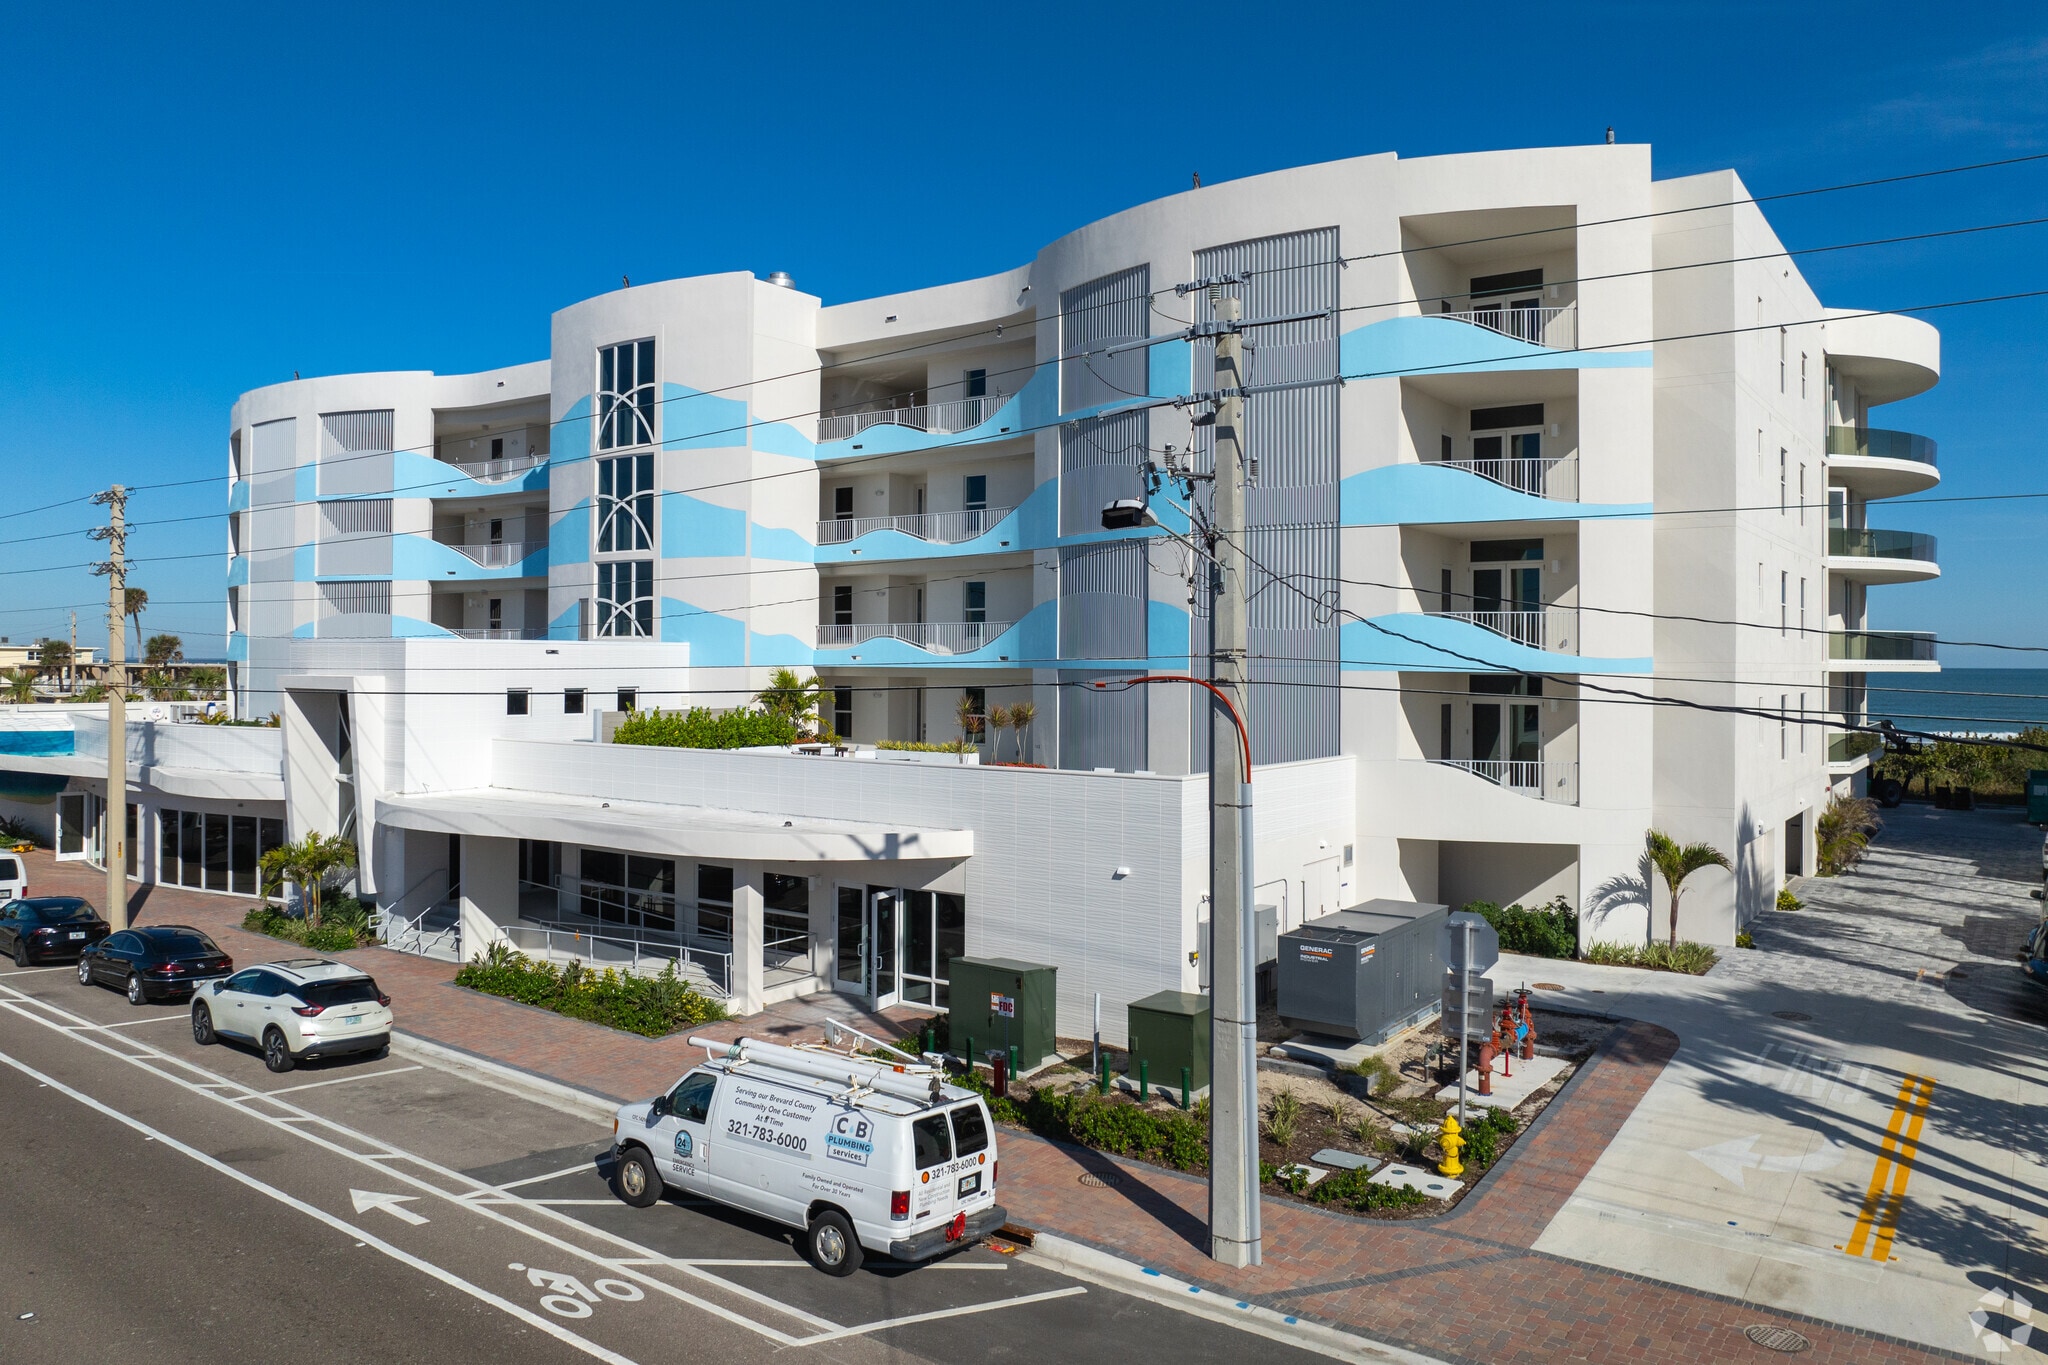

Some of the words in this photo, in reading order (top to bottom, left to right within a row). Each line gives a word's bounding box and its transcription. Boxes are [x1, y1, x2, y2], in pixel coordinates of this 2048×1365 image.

[1300, 945, 1332, 954] GENERAC
[999, 1001, 1013, 1012] FDC
[735, 1086, 757, 1099] Serving
[769, 1094, 794, 1105] Brevard
[794, 1101, 816, 1113] County
[735, 1097, 768, 1112] Community
[768, 1105, 781, 1114] One
[782, 1109, 812, 1122] Customer
[755, 1114, 763, 1122] At
[770, 1117, 784, 1127] Time
[837, 1117, 849, 1134] C
[855, 1121, 868, 1138] B
[728, 1119, 807, 1151] 321-783-6000
[828, 1136, 870, 1152] PLUMBING
[833, 1149, 862, 1161] services
[673, 1163, 695, 1176] SERVICE
[931, 1157, 977, 1179] 321-783-6000
[802, 1172, 816, 1181] Family
[817, 1176, 833, 1184] Owned
[842, 1183, 864, 1193] Operated
[838, 1190, 851, 1198] Years
